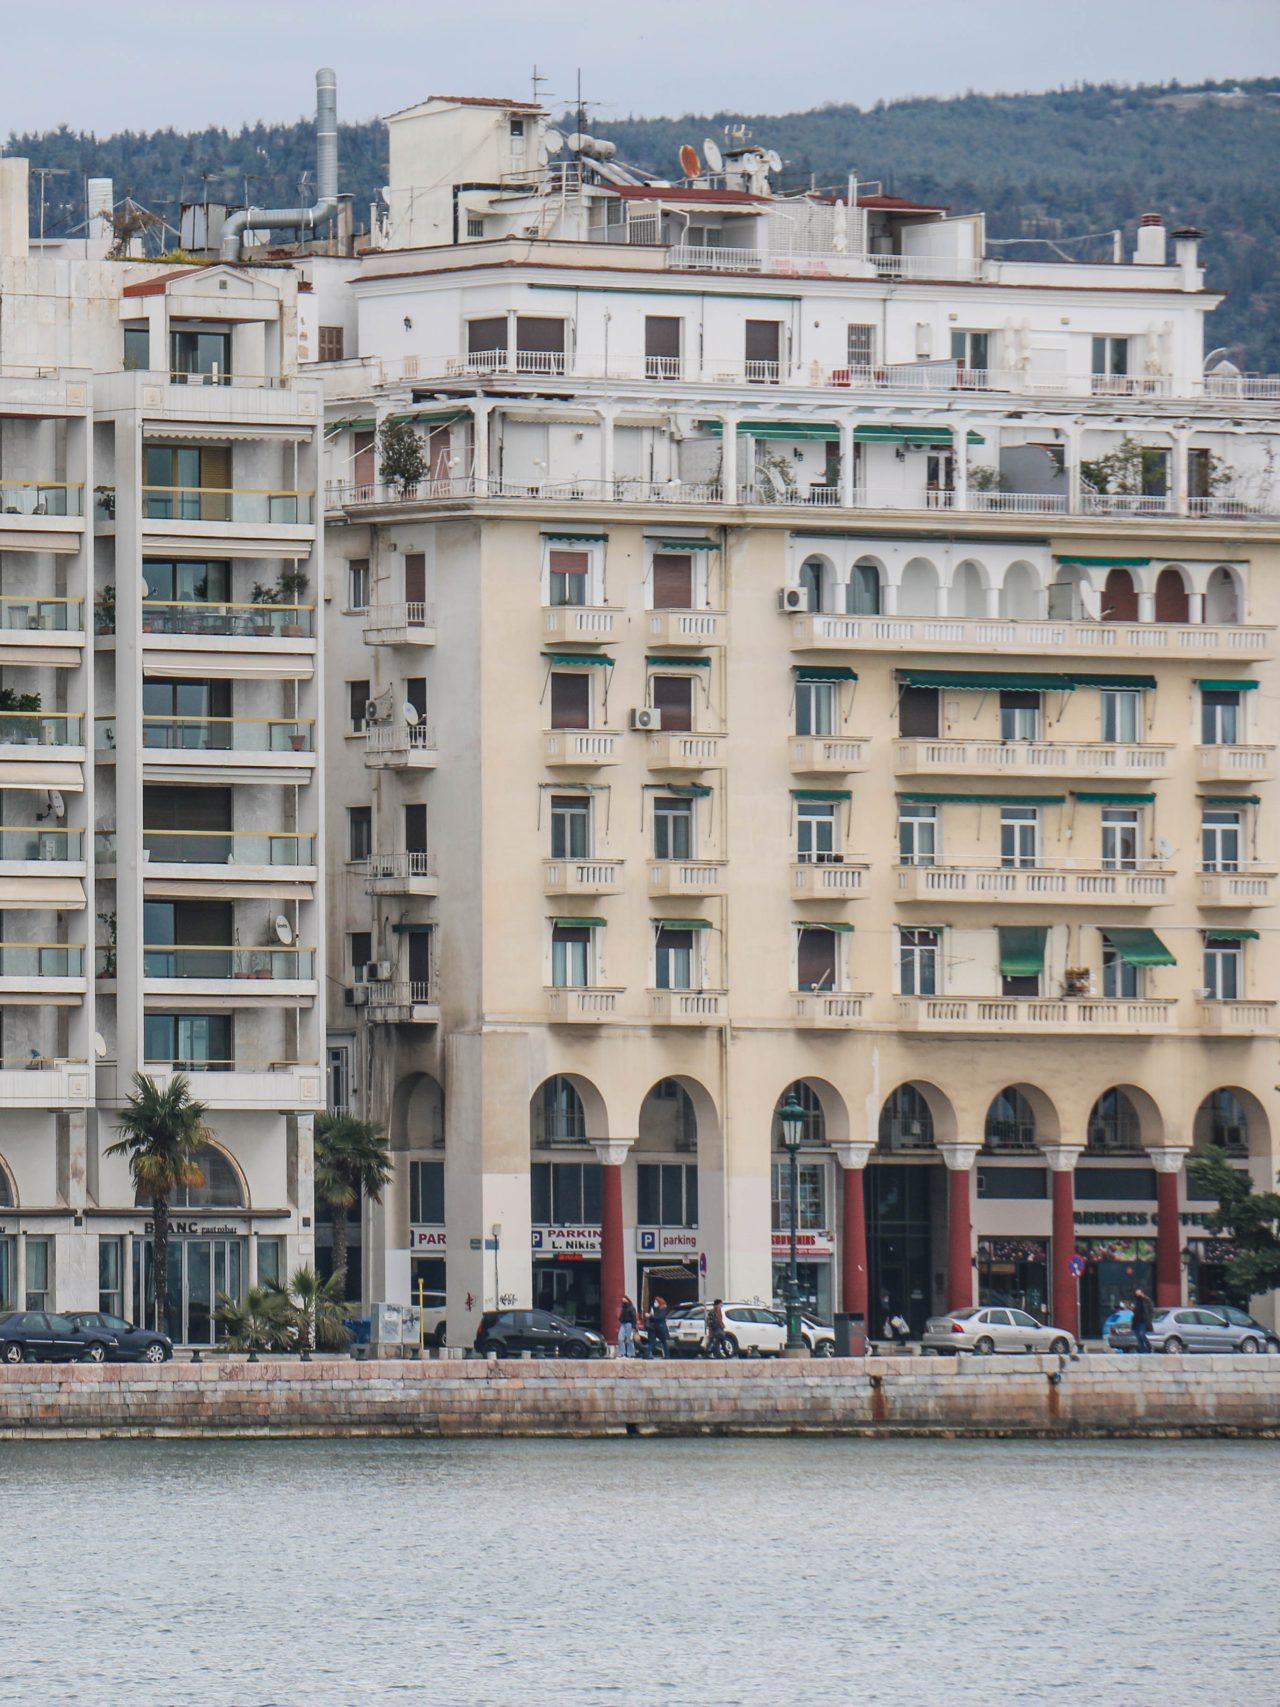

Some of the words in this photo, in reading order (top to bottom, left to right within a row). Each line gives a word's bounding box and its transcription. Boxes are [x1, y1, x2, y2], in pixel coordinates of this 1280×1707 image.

[144, 1222, 198, 1233] BANC
[201, 1224, 237, 1235] gastrobar
[552, 1241, 562, 1249] L.
[565, 1240, 596, 1249] Nikis
[663, 1234, 697, 1248] parking
[771, 1234, 816, 1246] SOUVNIRS
